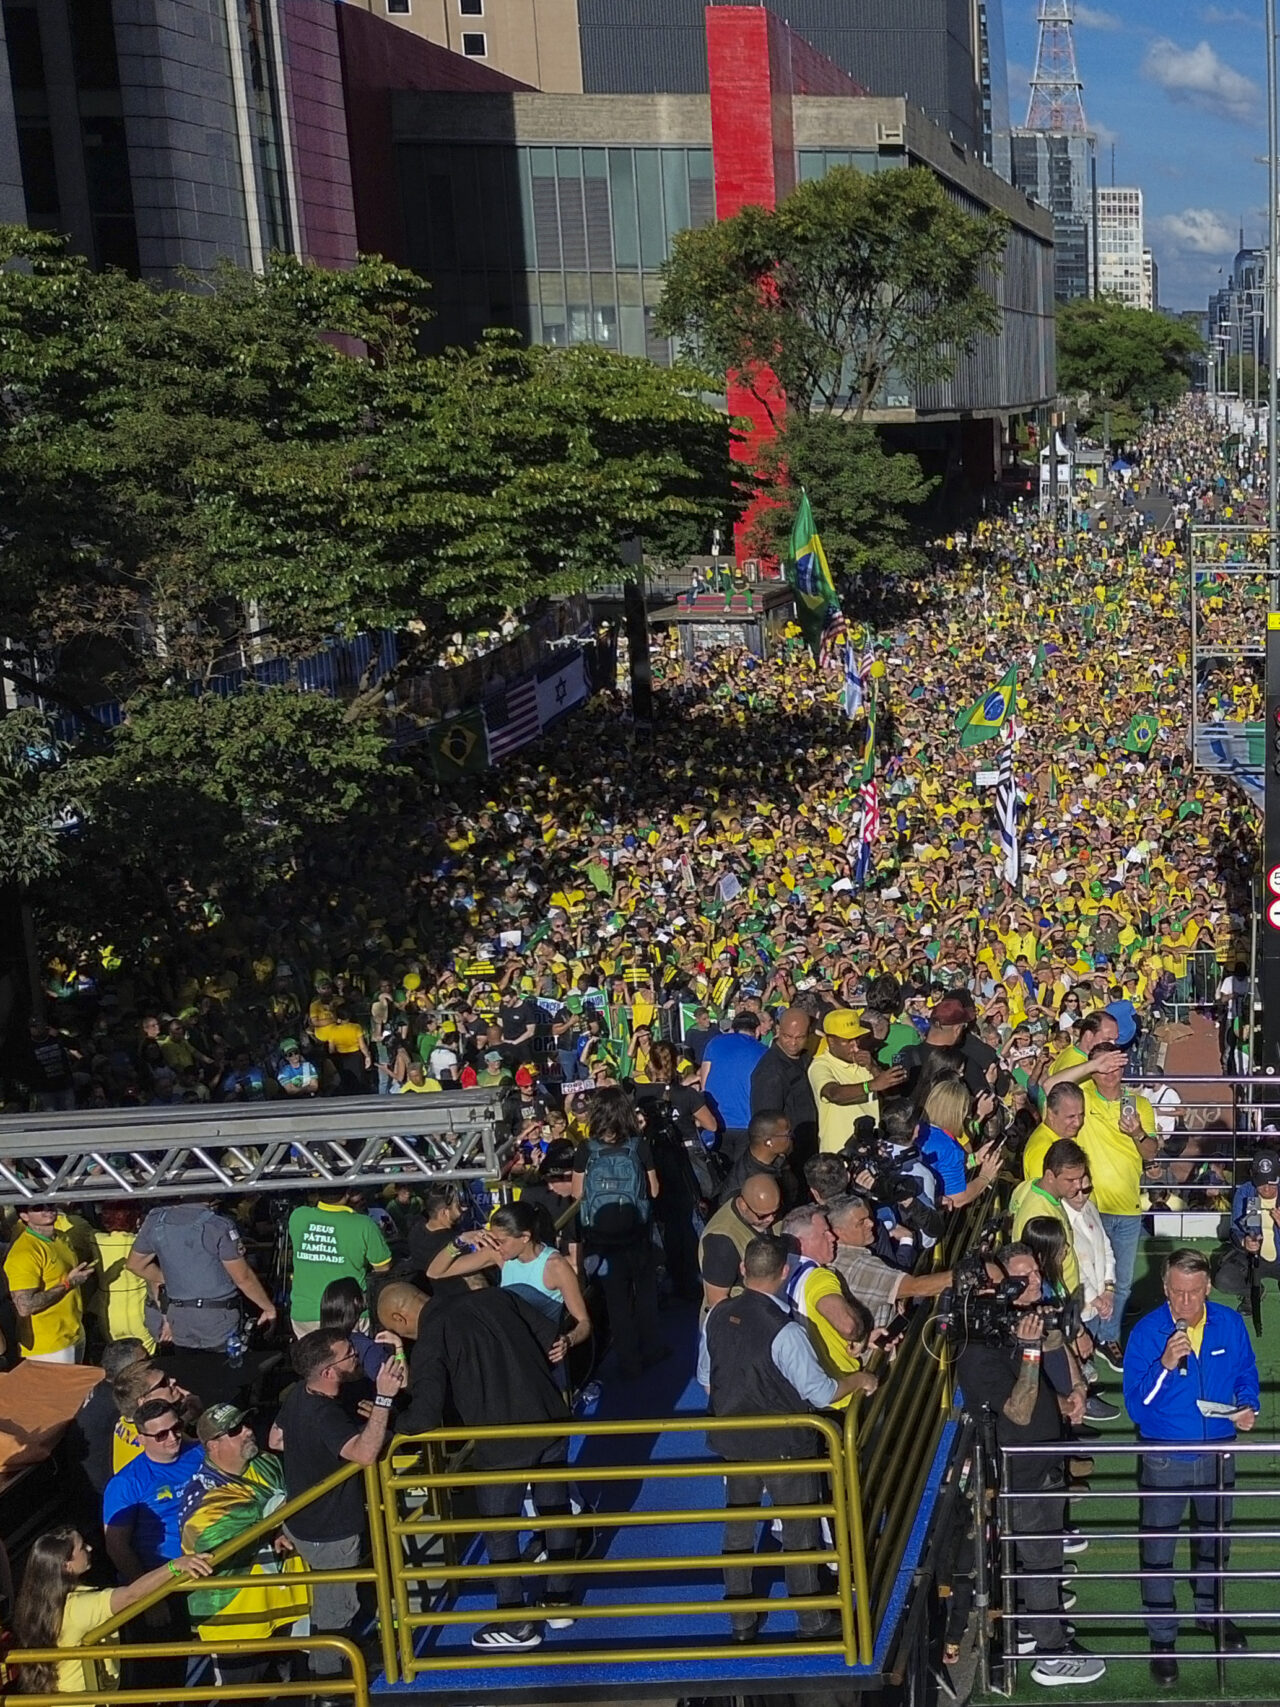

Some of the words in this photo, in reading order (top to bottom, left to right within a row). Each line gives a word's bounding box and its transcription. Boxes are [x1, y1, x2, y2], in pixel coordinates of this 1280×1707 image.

[309, 1224, 334, 1234] DEUS
[303, 1233, 337, 1244] PÁTRIA
[301, 1243, 337, 1254] FAMÍLIA
[297, 1251, 345, 1264] LIBERDADE
